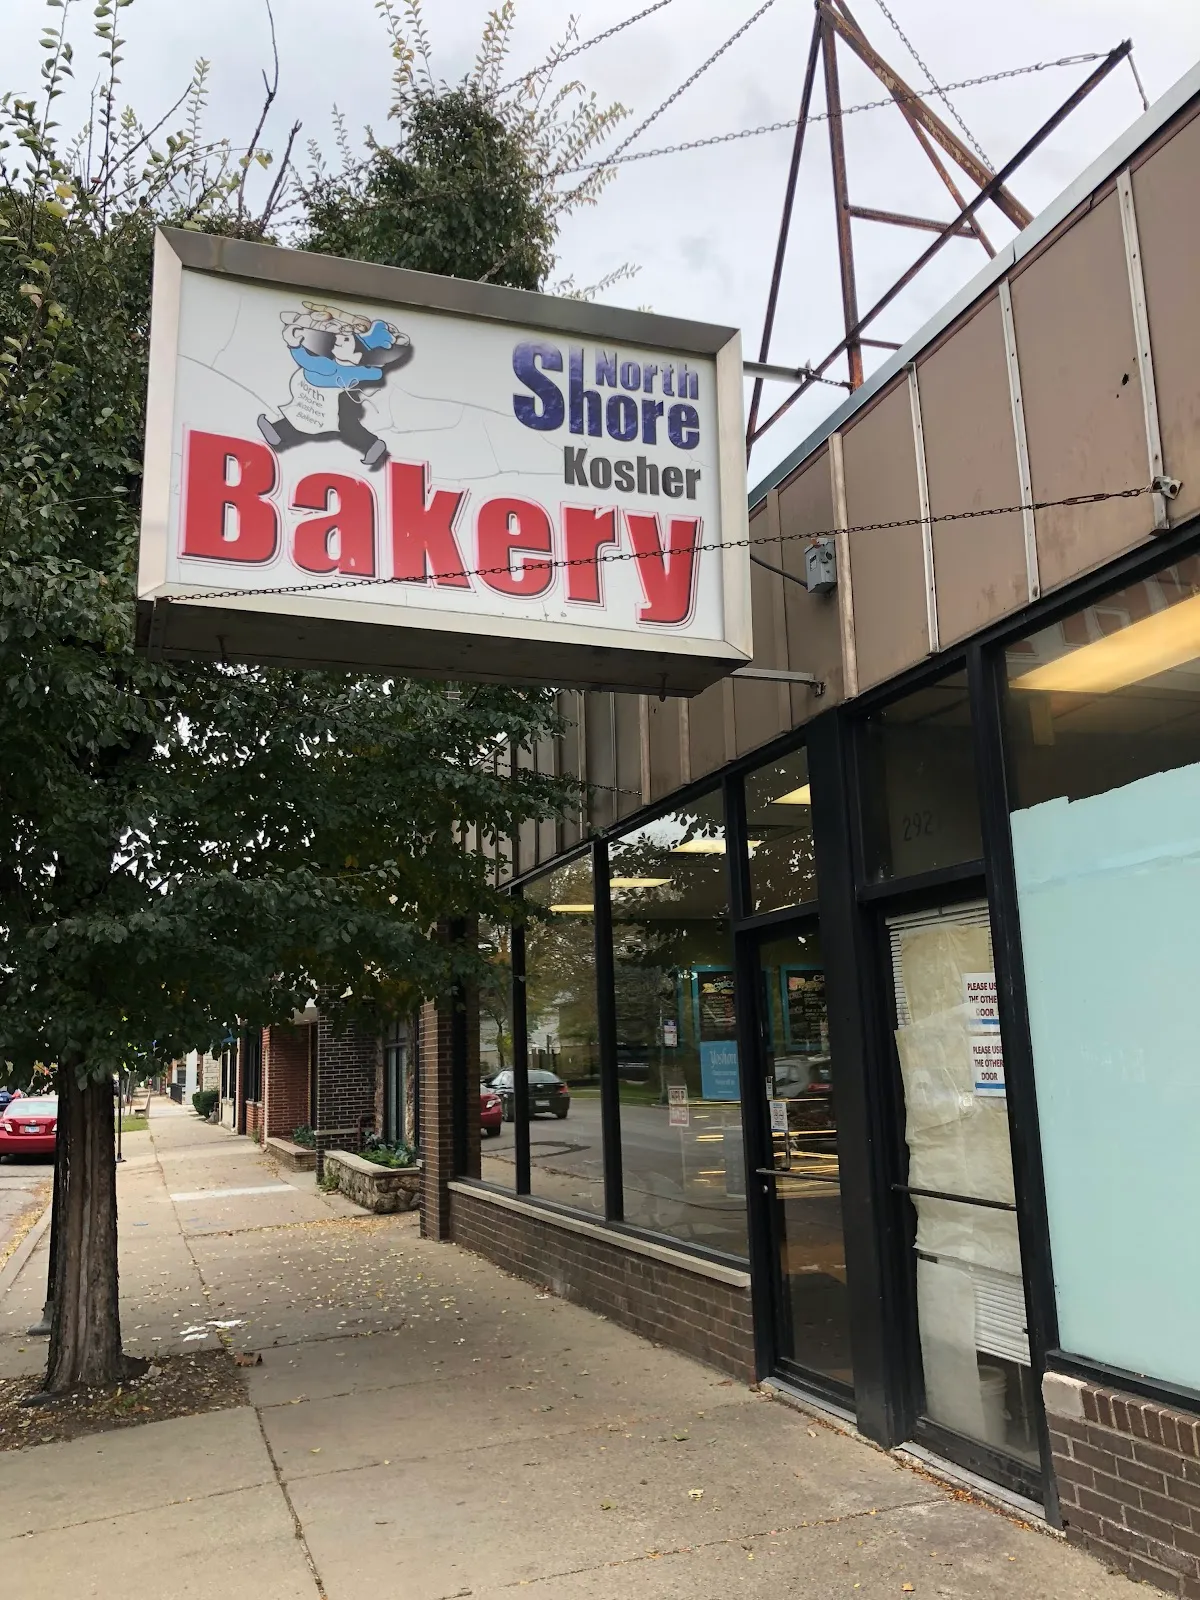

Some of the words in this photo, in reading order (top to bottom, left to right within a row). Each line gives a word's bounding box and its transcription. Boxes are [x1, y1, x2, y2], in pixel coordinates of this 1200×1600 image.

[594, 347, 700, 401] North
[297, 380, 325, 402] North
[511, 339, 701, 451] Shore
[297, 392, 323, 409] Shore
[296, 411, 324, 428] Bakery
[563, 445, 701, 501] Kosher
[178, 426, 702, 629] Bakery
[967, 982, 988, 991] PLEASE
[988, 982, 997, 991] US
[980, 995, 998, 1005] OTHE
[972, 1045, 992, 1055] PLEASE
[974, 1059, 984, 1068] THE
[984, 1059, 1004, 1069] OTHER
[981, 1072, 998, 1081] DOOR
